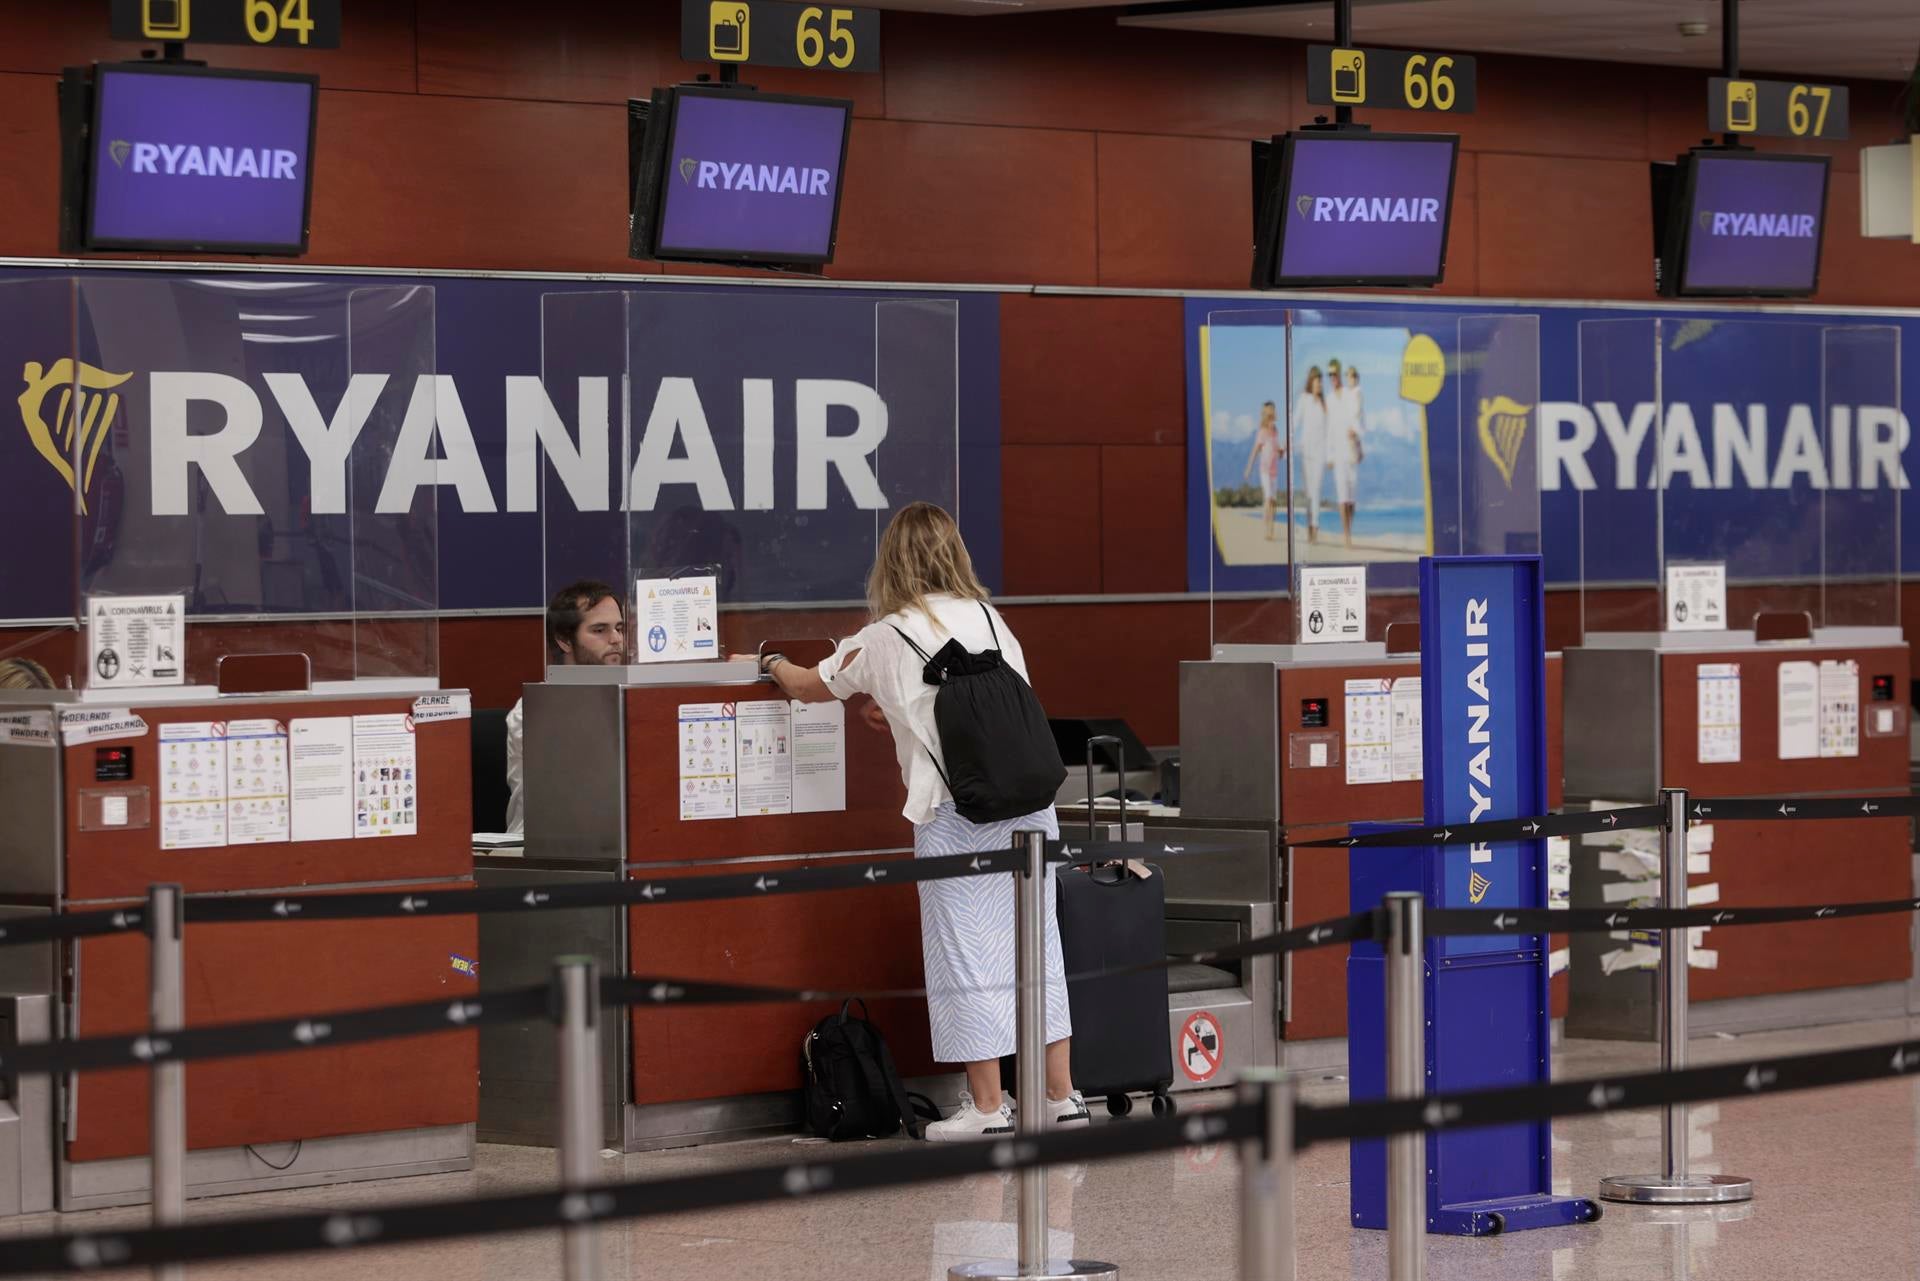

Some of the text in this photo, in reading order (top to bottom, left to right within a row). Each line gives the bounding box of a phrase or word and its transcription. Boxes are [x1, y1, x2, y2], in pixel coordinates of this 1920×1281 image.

[245, 0, 314, 44] 64
[796, 8, 856, 69] 65
[1403, 55, 1456, 111] 66
[1788, 85, 1831, 137] 67
[132, 142, 298, 180] RYANAIR
[697, 160, 831, 196] RYANAIR
[1313, 197, 1440, 223] RYANAIR
[1712, 212, 1815, 238] RYANAIR
[149, 371, 889, 516] RYANAIR
[1538, 401, 1911, 491] RYANAIR
[111, 606, 164, 616] CORONAVIRUS
[658, 586, 700, 597] CORONAVIRUS
